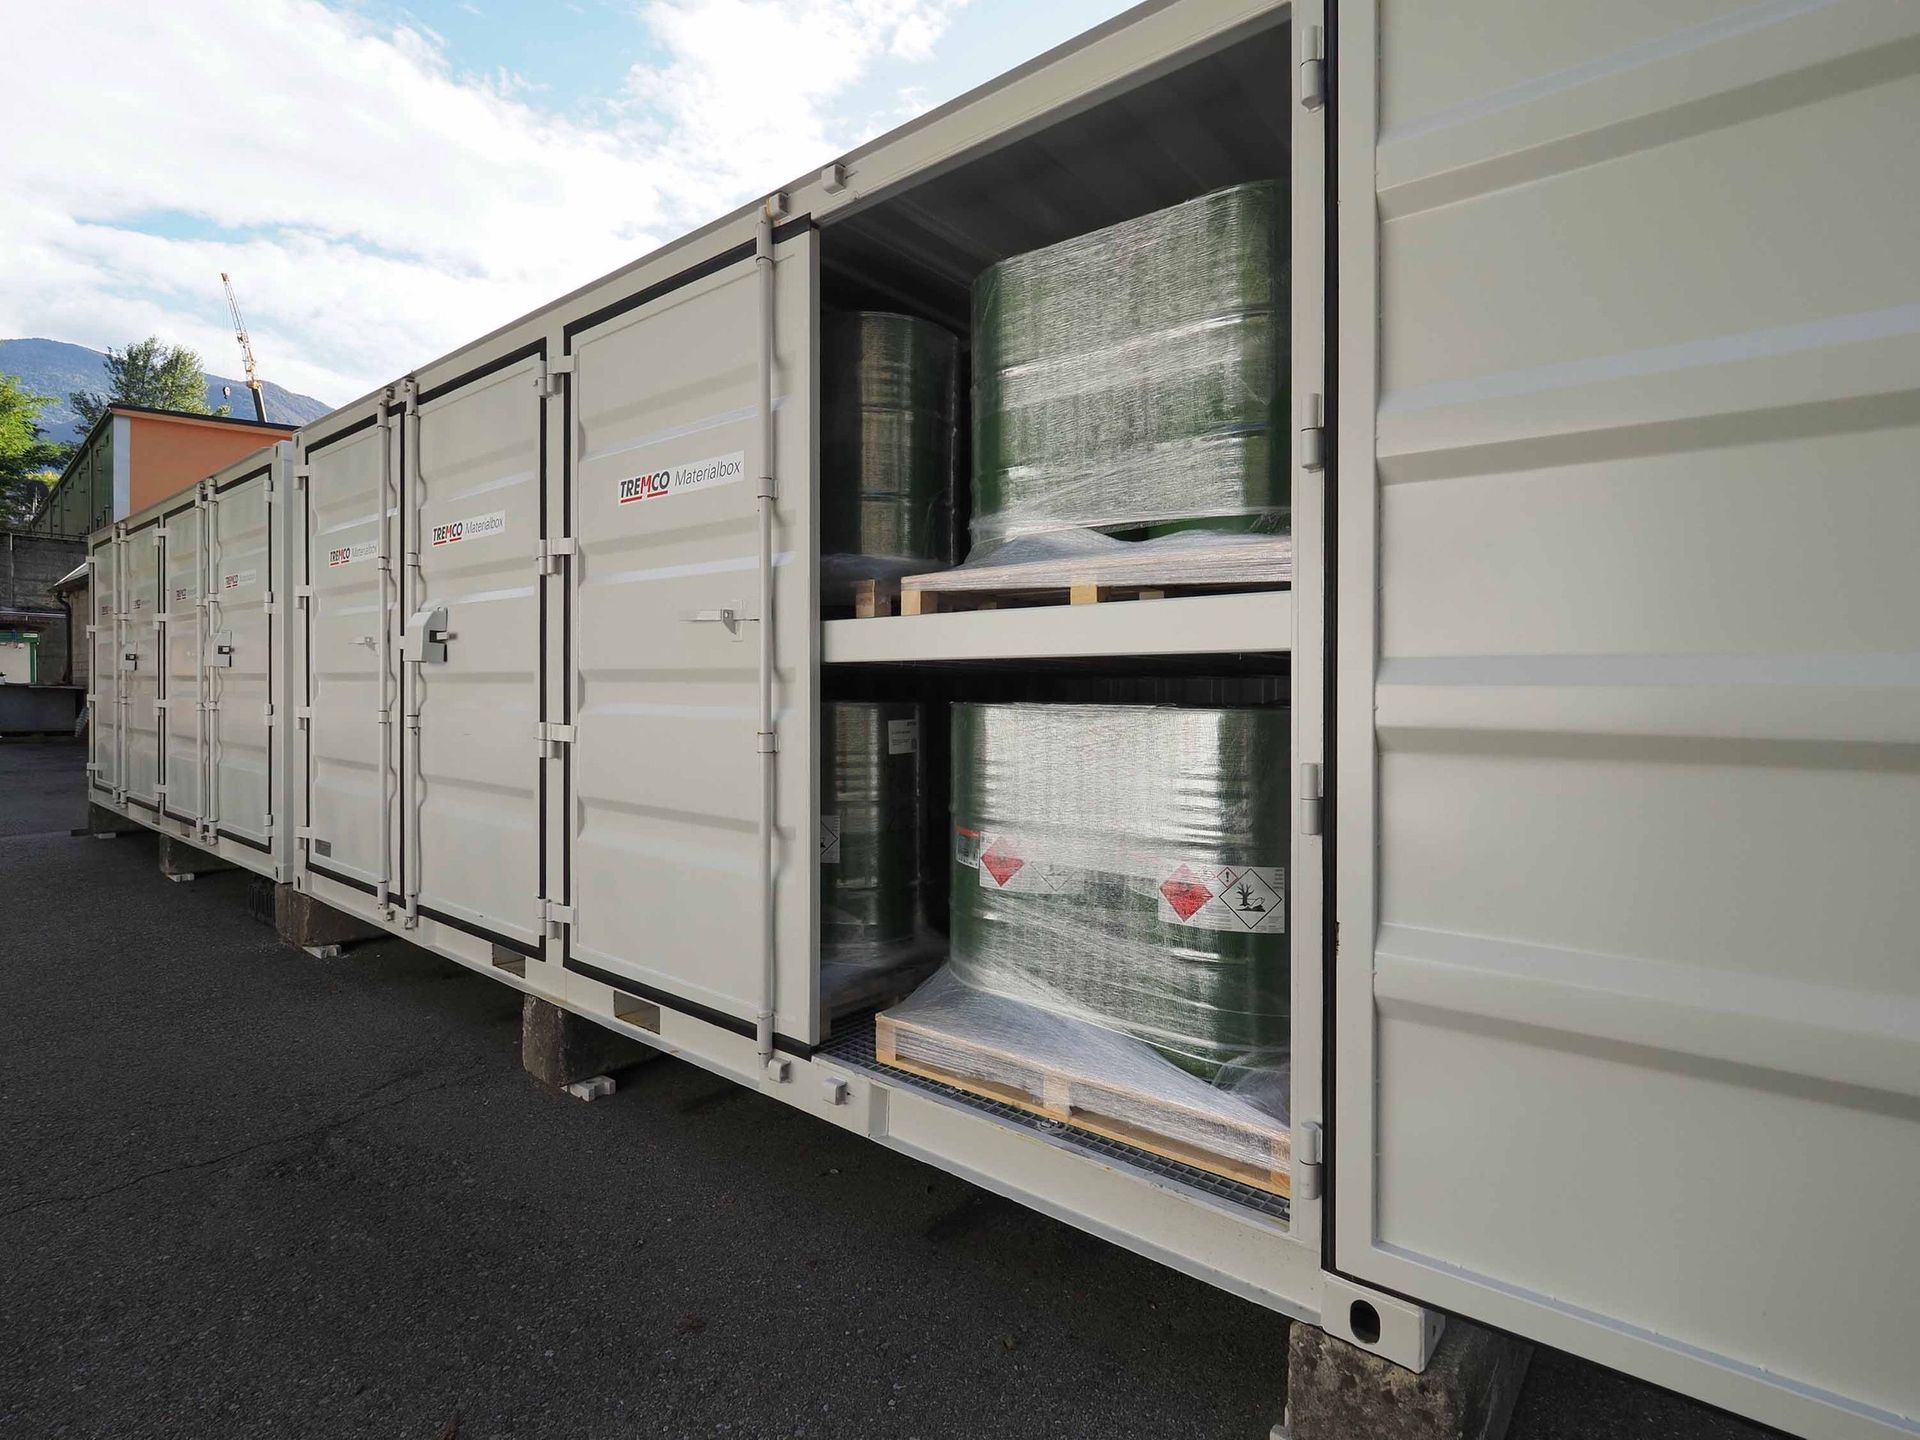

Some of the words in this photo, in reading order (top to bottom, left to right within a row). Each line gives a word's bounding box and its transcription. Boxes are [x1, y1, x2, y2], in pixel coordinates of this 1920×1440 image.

[619, 470, 671, 500] TREMCO
[674, 458, 743, 487] Materialbox
[433, 521, 464, 542] TREMCO
